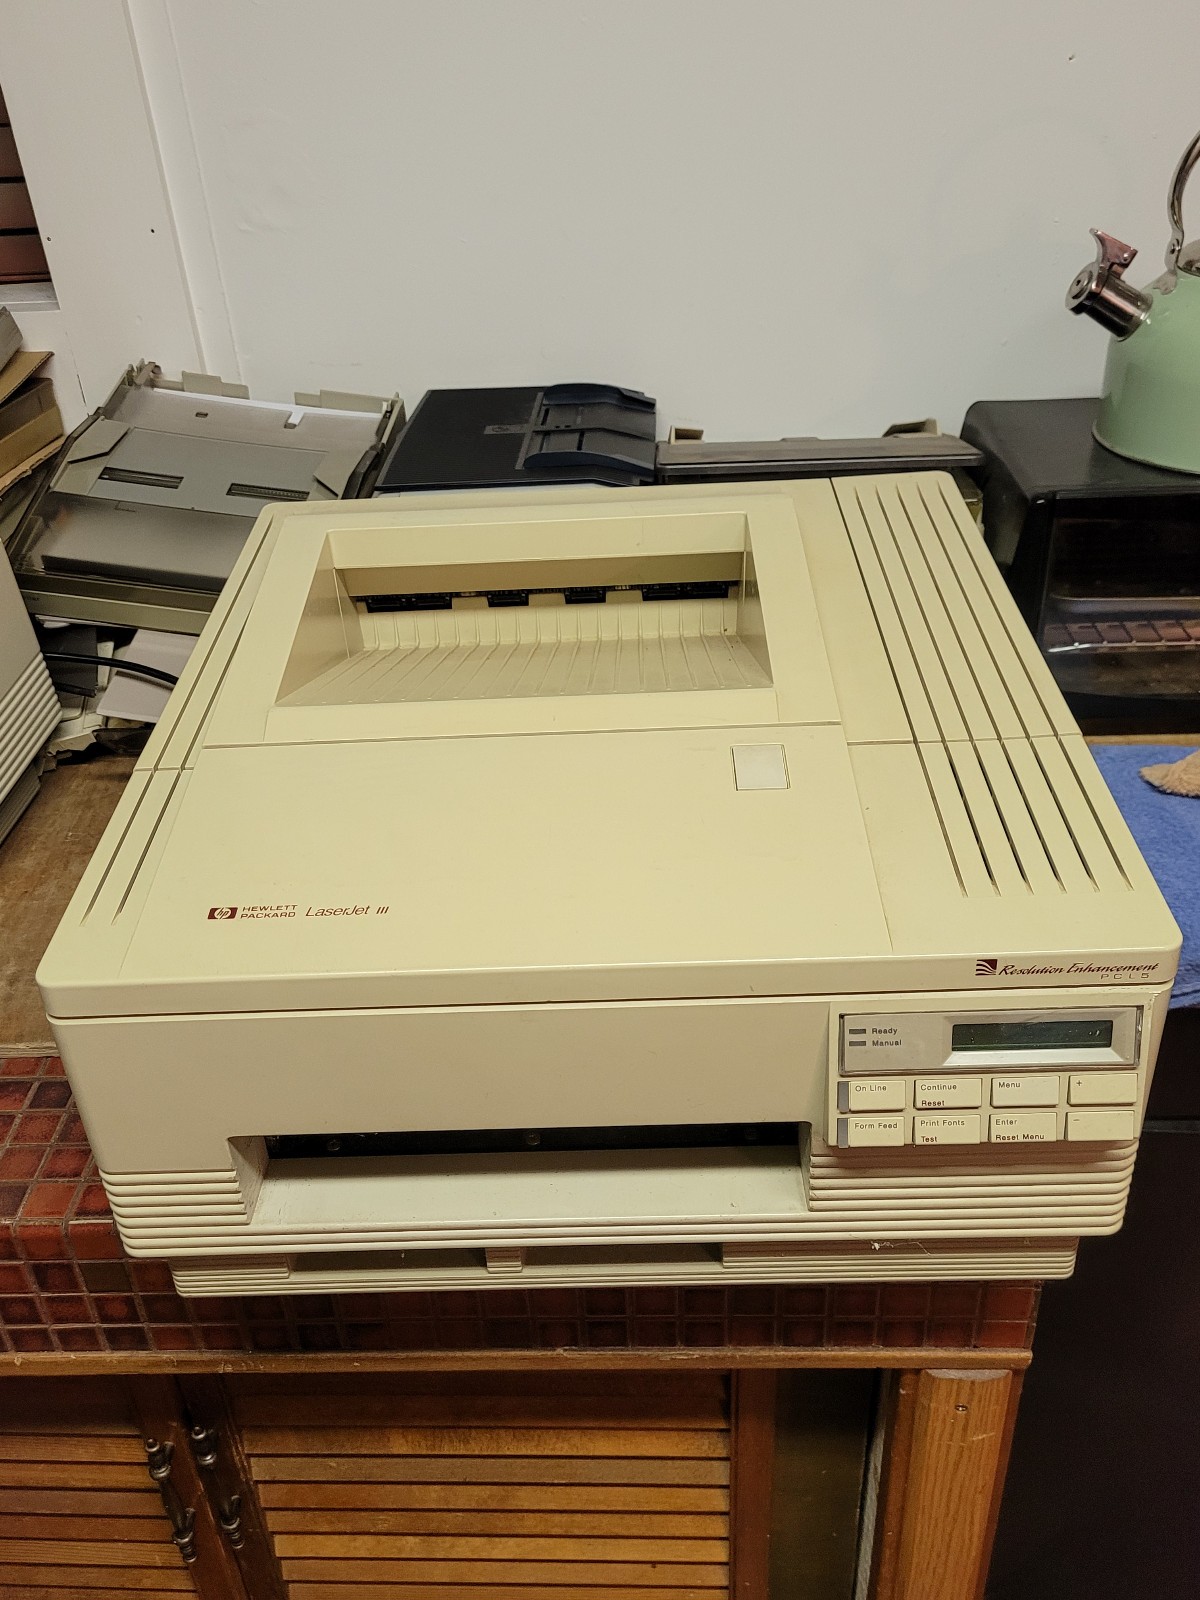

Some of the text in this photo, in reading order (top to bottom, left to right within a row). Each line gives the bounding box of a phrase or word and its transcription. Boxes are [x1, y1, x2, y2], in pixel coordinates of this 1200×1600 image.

[305, 905, 390, 917] LaserJet III
[998, 962, 1160, 976] Resolution Enhancement
[871, 1027, 898, 1036] Ready
[872, 1039, 902, 1047] Manual
[869, 1084, 887, 1092] Line
[920, 1083, 957, 1091] Continue
[998, 1081, 1021, 1089] Menu
[878, 1122, 898, 1130] Feed
[995, 1118, 1018, 1126] Enter
[920, 1135, 938, 1143] Test
